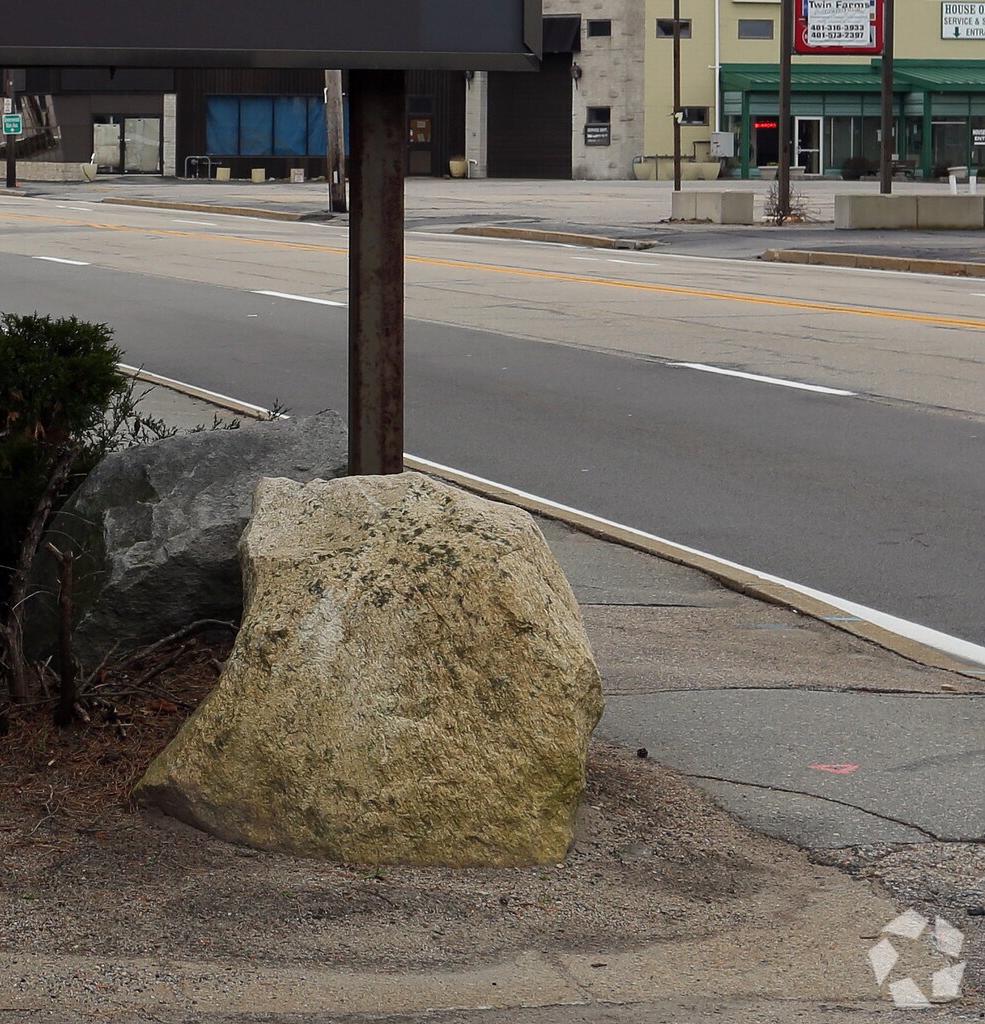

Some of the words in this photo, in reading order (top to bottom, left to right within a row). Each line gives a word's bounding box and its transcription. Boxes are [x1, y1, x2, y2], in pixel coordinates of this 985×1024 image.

[809, 0, 832, 9] Twin
[835, 0, 871, 9] Farms
[945, 4, 976, 15] HOUSE
[943, 17, 973, 25] SERVICE
[974, 17, 980, 25] &
[966, 28, 985, 36] ENTR
